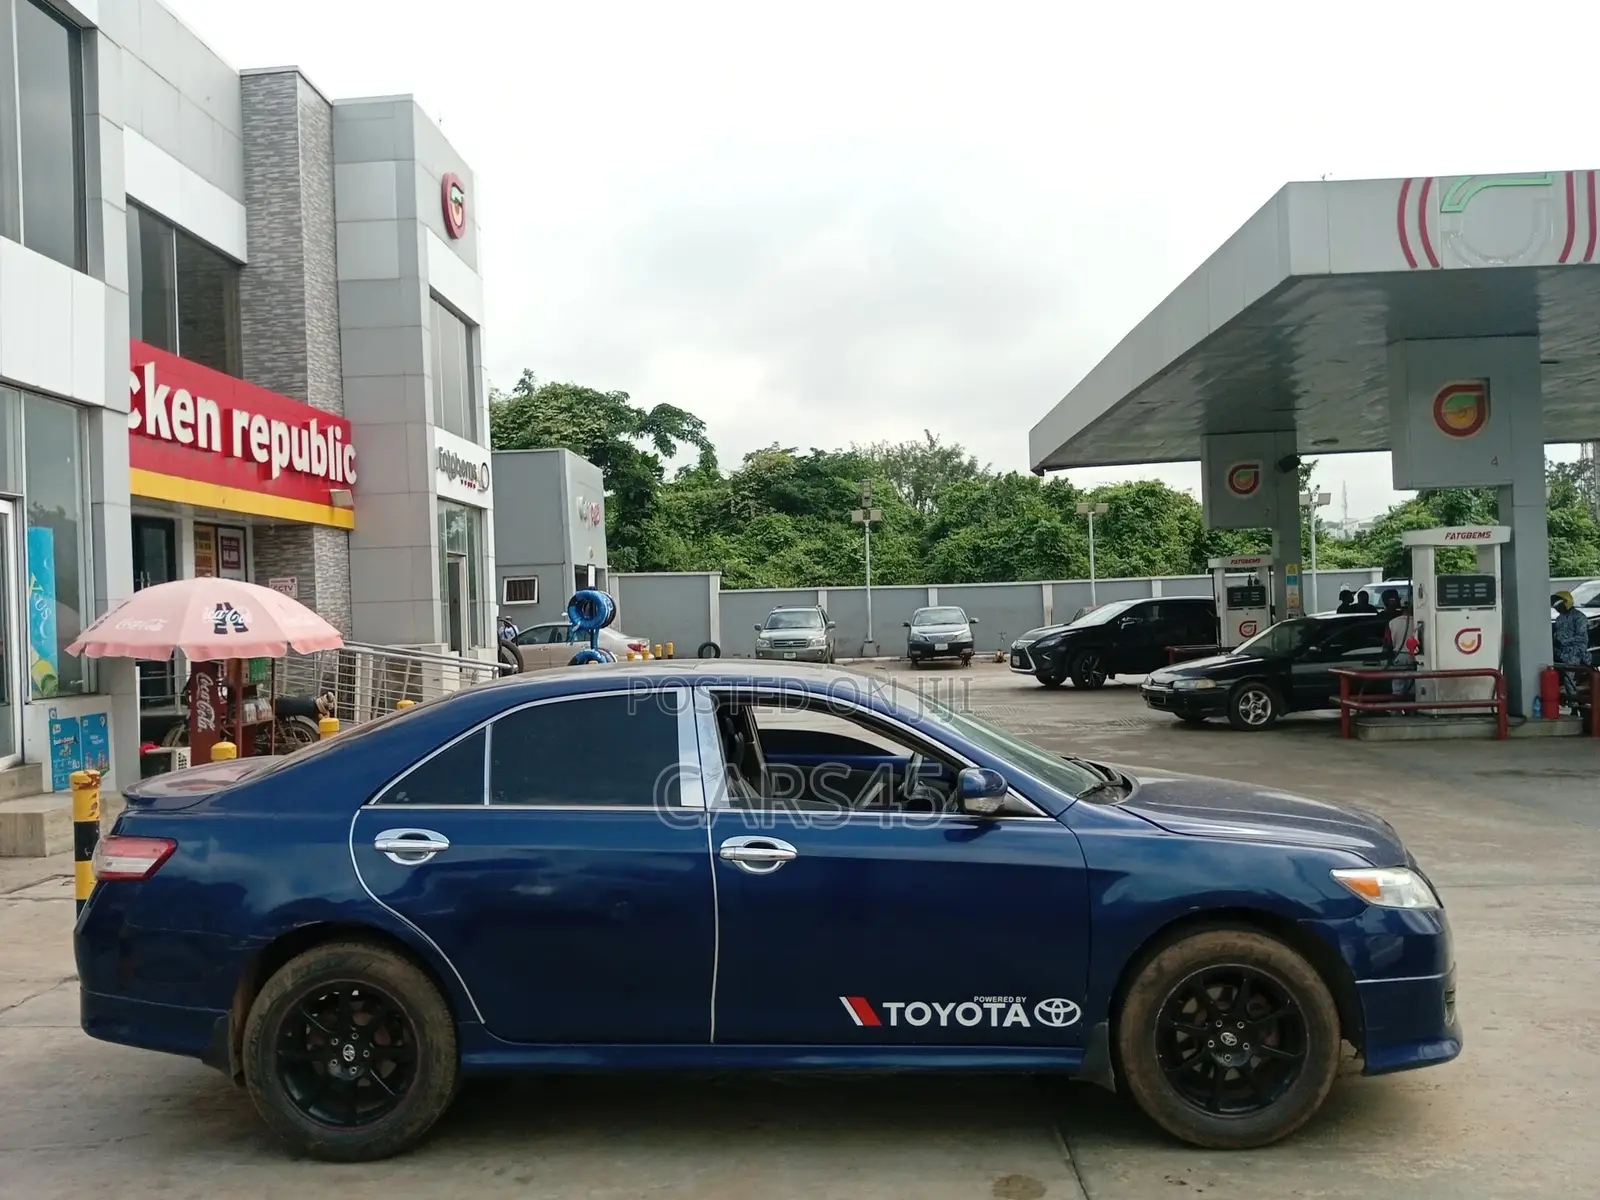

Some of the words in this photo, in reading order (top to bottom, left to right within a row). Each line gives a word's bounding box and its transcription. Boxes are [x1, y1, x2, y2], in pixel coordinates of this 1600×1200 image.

[232, 408, 357, 485] republic
[1490, 455, 1499, 467] 4
[1444, 530, 1492, 541] FATGBEMS
[882, 1001, 1031, 1028] TOYOTA
